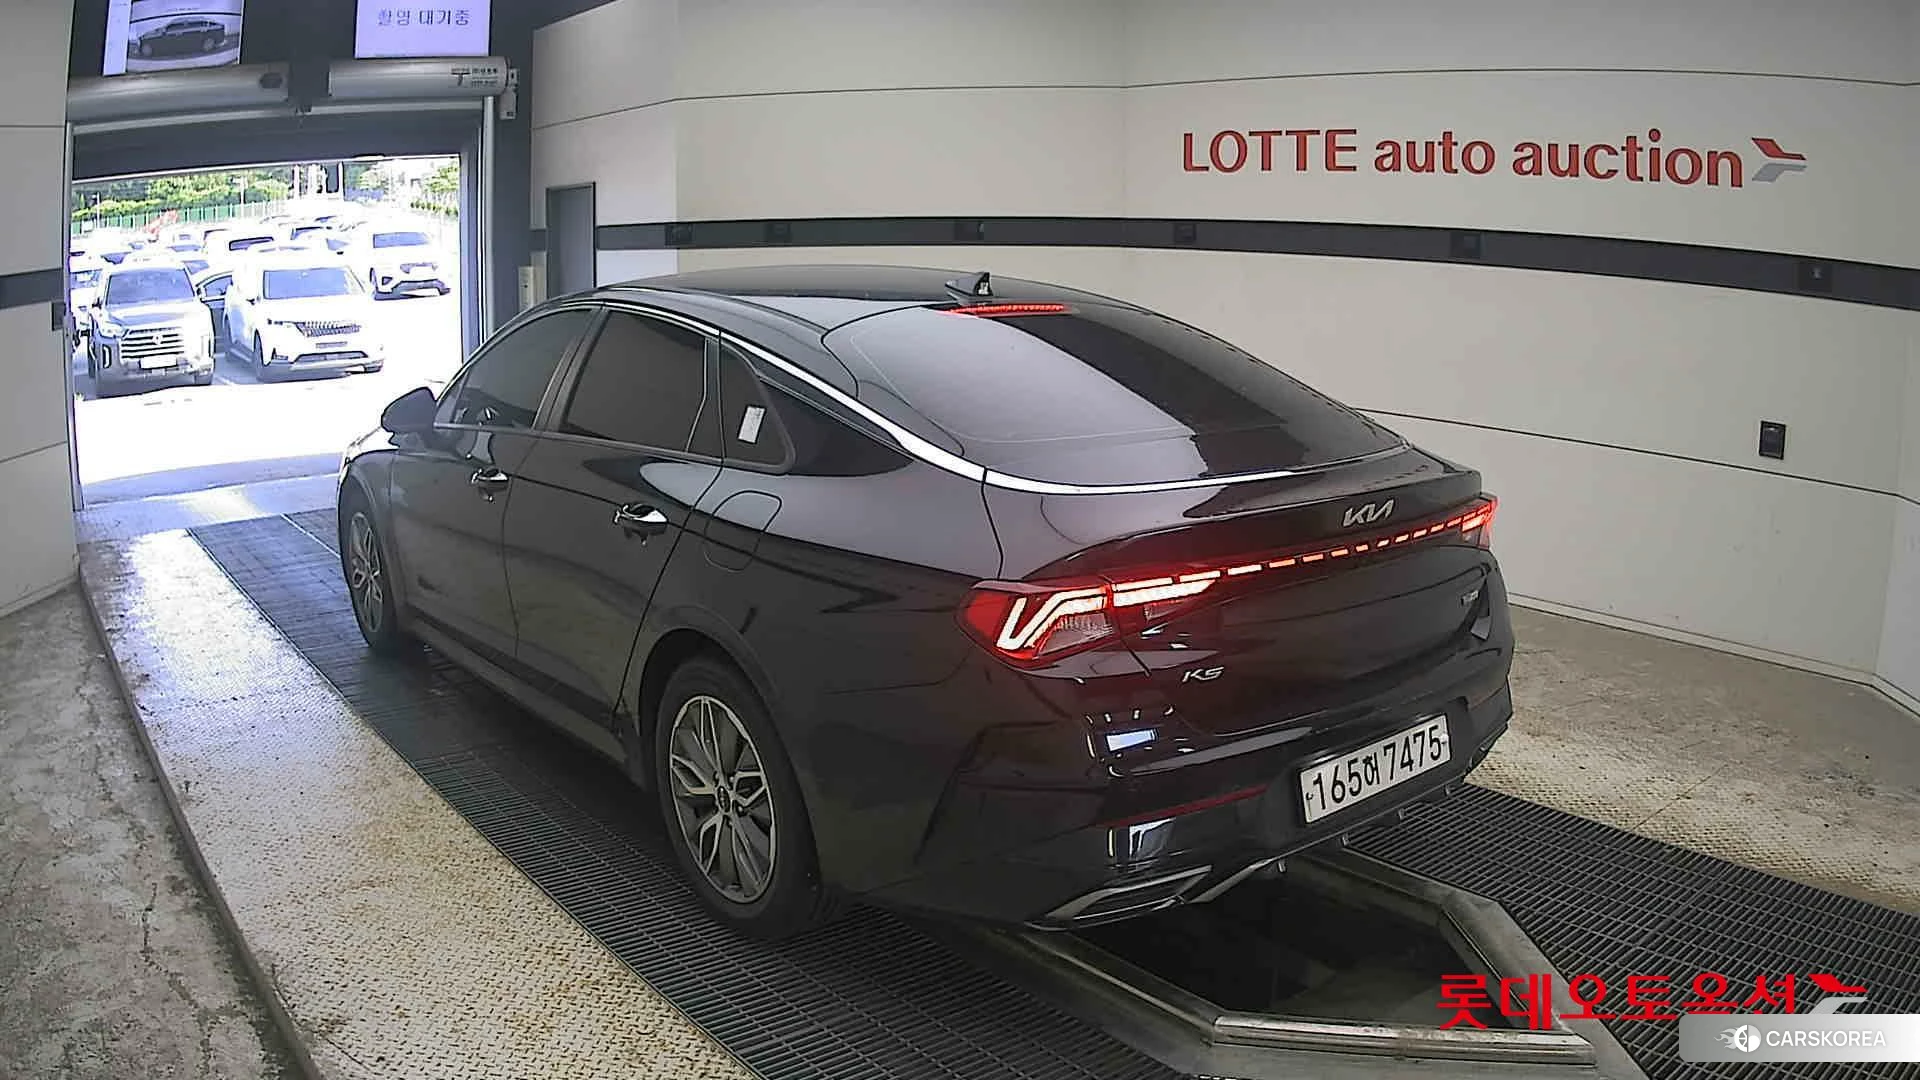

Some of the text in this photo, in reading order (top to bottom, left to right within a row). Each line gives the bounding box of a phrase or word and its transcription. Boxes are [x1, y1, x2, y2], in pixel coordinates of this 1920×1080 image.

[419, 9, 472, 26] 대기중
[1183, 128, 1743, 188] LOTTE auto auction
[1182, 666, 1224, 682] K5
